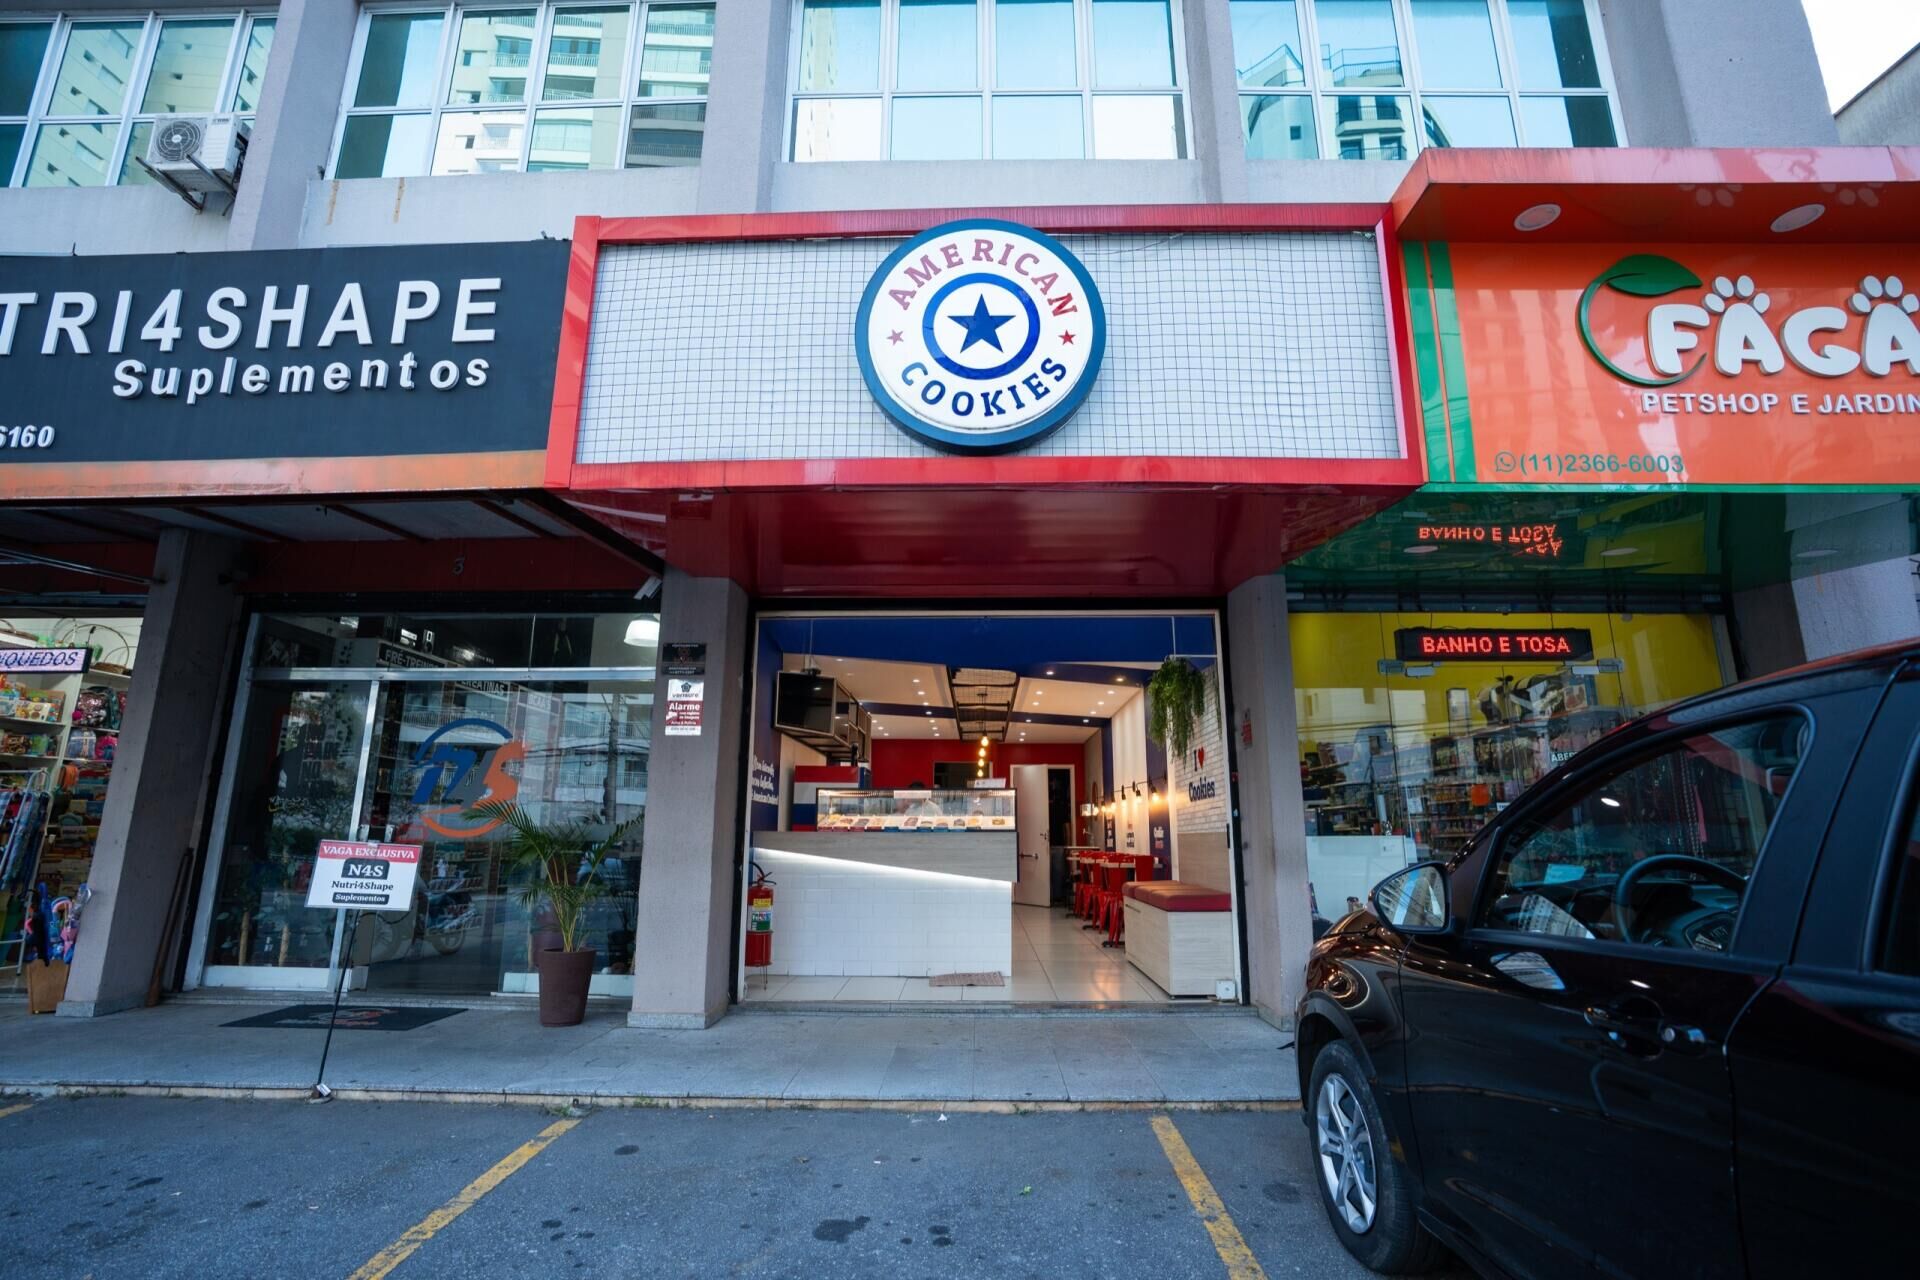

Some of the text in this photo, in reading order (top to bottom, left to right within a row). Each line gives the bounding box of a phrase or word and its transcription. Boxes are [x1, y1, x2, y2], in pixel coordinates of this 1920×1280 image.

[888, 239, 1077, 317] AMERICAN
[113, 352, 490, 404] Suplementos
[901, 357, 1067, 417] COOKIES
[1642, 393, 1779, 414] PETSHOP
[1792, 394, 1811, 414] E
[1520, 453, 1684, 477] (11)2366-6003
[1422, 636, 1570, 653] BANHO E TOSA
[669, 702, 701, 711] Alarme
[1551, 752, 1578, 762] ABER
[1189, 777, 1216, 802] Cookies
[323, 846, 415, 859] VAGA EXCLUSIVA
[348, 864, 384, 877] N4S
[331, 881, 394, 891] Nutri4Shape
[335, 893, 386, 902] Suplementos
